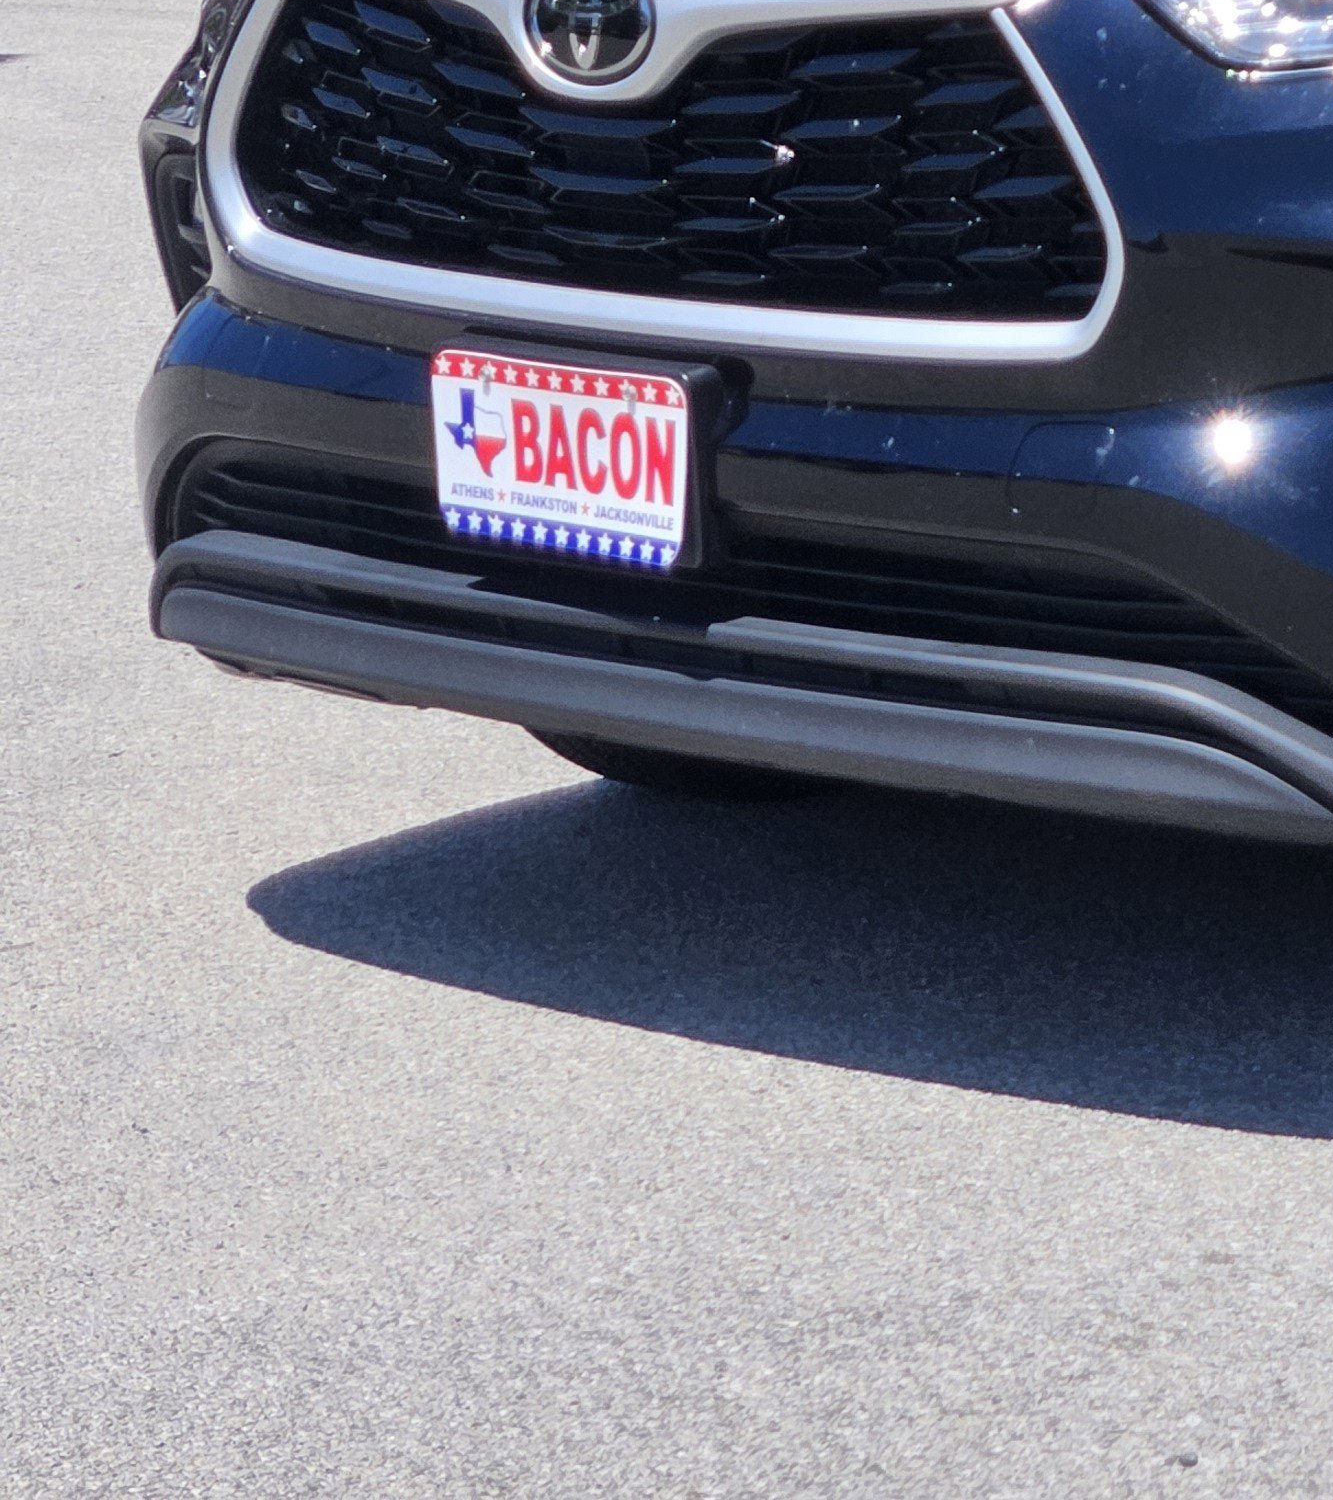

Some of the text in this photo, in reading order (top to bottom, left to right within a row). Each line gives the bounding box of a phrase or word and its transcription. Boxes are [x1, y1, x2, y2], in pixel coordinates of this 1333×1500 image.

[511, 398, 676, 506] BACON
[451, 483, 675, 531] ATHENS FRANKSTON JACKSONVILLE
